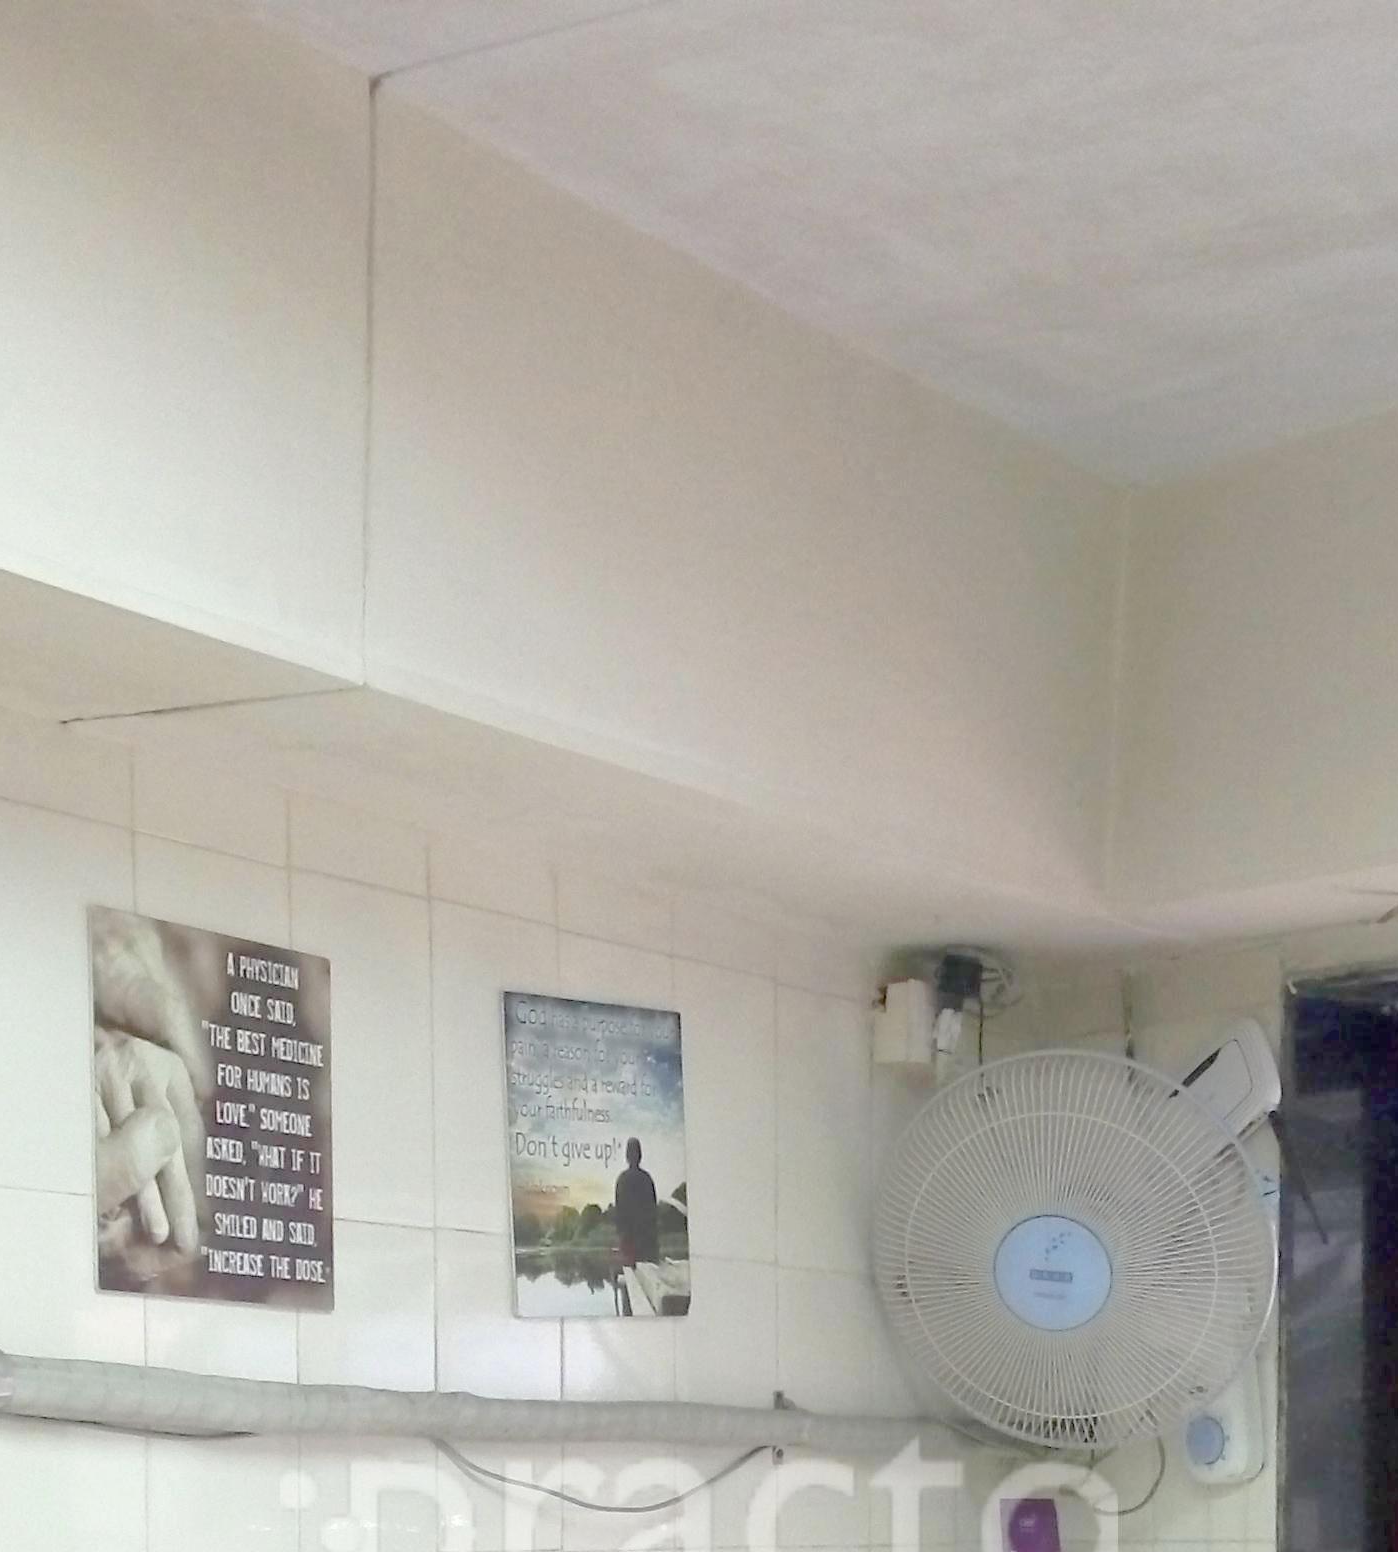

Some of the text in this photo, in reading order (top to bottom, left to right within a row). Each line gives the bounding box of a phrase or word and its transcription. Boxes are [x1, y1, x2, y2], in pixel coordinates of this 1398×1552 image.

[226, 952, 300, 990] A PHYSICIAN
[230, 991, 297, 1027] ONCE SAID,
[236, 1028, 267, 1056] BEST
[270, 1036, 324, 1068] MEDICINE
[217, 1063, 311, 1101] FOR HUMANS IS
[259, 1108, 313, 1138] SOMEONE
[206, 1136, 247, 1166] ASKED,
[290, 1149, 305, 1174] IF
[309, 1152, 322, 1175] IT
[515, 1132, 559, 1159] Don't
[561, 1140, 591, 1167] give
[205, 1173, 256, 1203] DOESN'T
[308, 1188, 324, 1211] HE
[214, 1212, 257, 1240] SMILED
[261, 1218, 284, 1243] AND
[269, 1254, 292, 1280] THE
